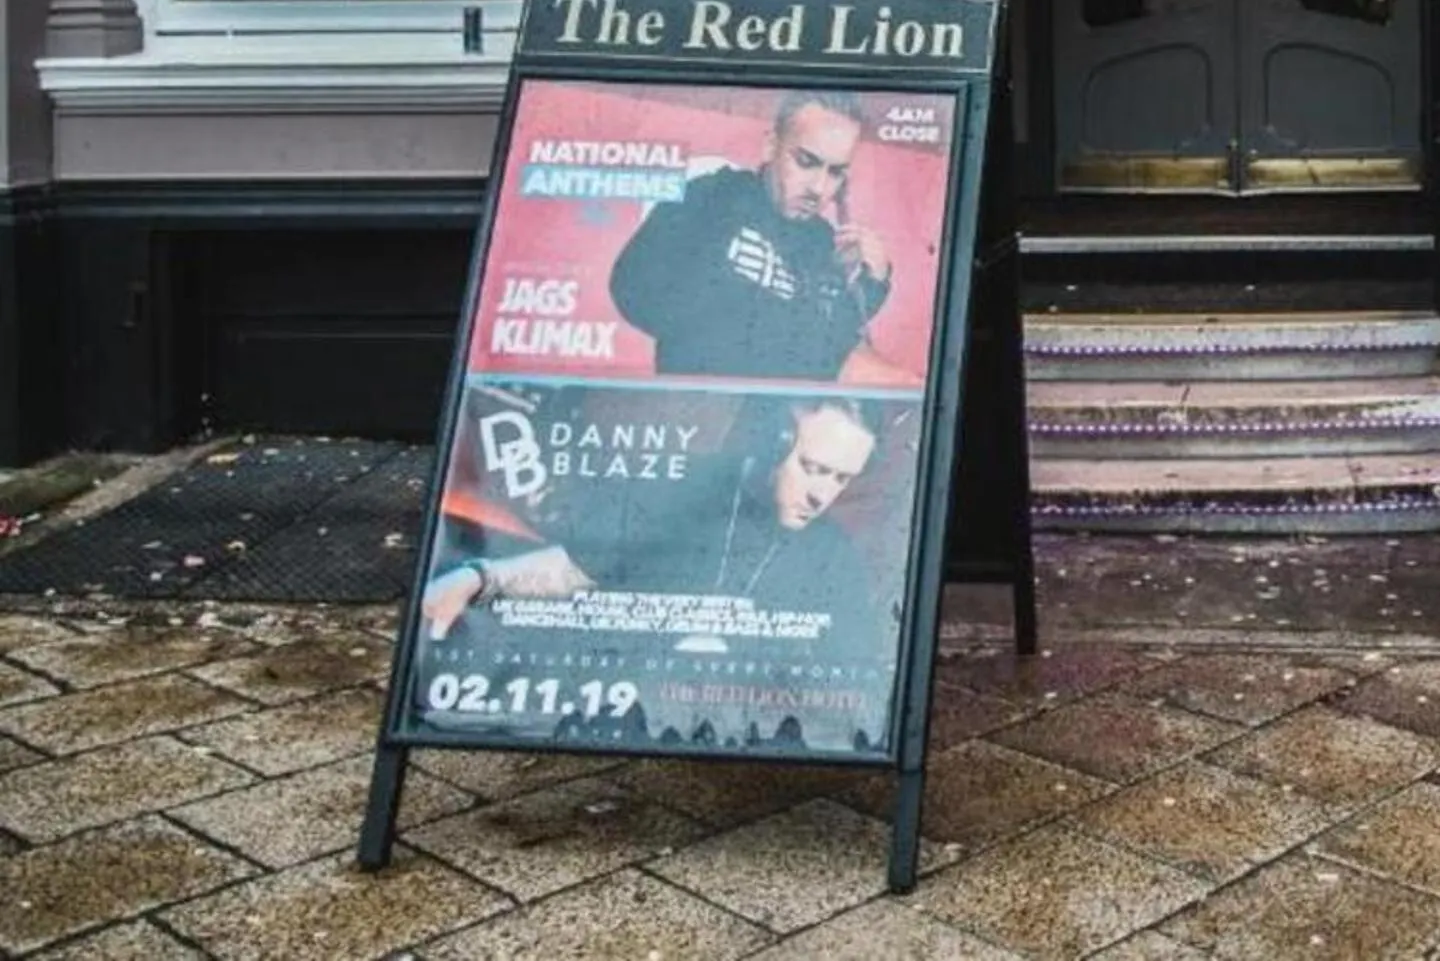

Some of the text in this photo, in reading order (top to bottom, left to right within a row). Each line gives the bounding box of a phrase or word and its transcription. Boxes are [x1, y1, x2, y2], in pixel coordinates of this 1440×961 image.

[682, 0, 806, 52] Red
[821, 4, 965, 58] Lion
[878, 125, 940, 142] CLOSE
[530, 140, 687, 168] NATIONAL
[522, 168, 684, 201] ANTHEMS
[497, 277, 579, 316] JAGS
[490, 316, 617, 359] KLIMAX
[550, 421, 699, 451] DANNY
[552, 451, 689, 479] BLAZE
[428, 673, 639, 723] 02.11.19
